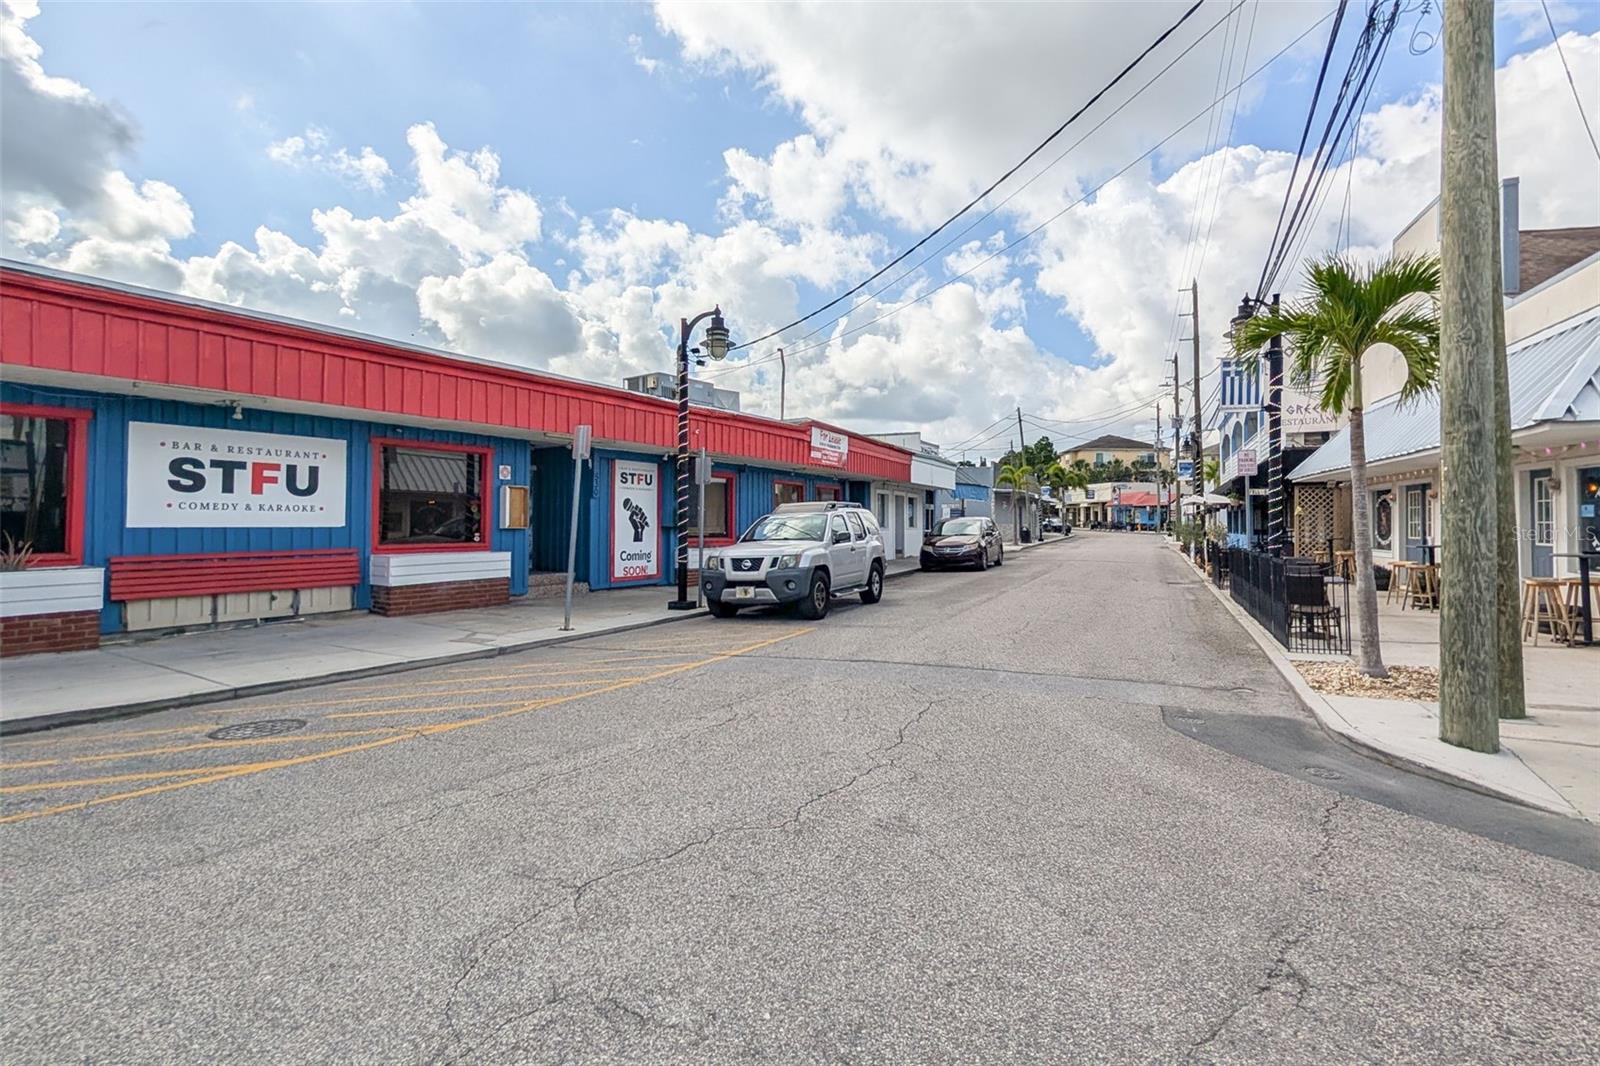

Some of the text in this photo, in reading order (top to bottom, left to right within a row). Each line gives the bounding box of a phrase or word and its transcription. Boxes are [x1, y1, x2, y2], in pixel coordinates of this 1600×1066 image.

[1286, 403, 1322, 415] GREE
[172, 441, 319, 459] BAR & RESTAURANT
[168, 457, 319, 497] STFU
[620, 471, 653, 486] STFU
[178, 501, 316, 512] COMEDY & KARAOKE
[620, 550, 652, 563] Coming
[623, 565, 648, 576] SOON!
